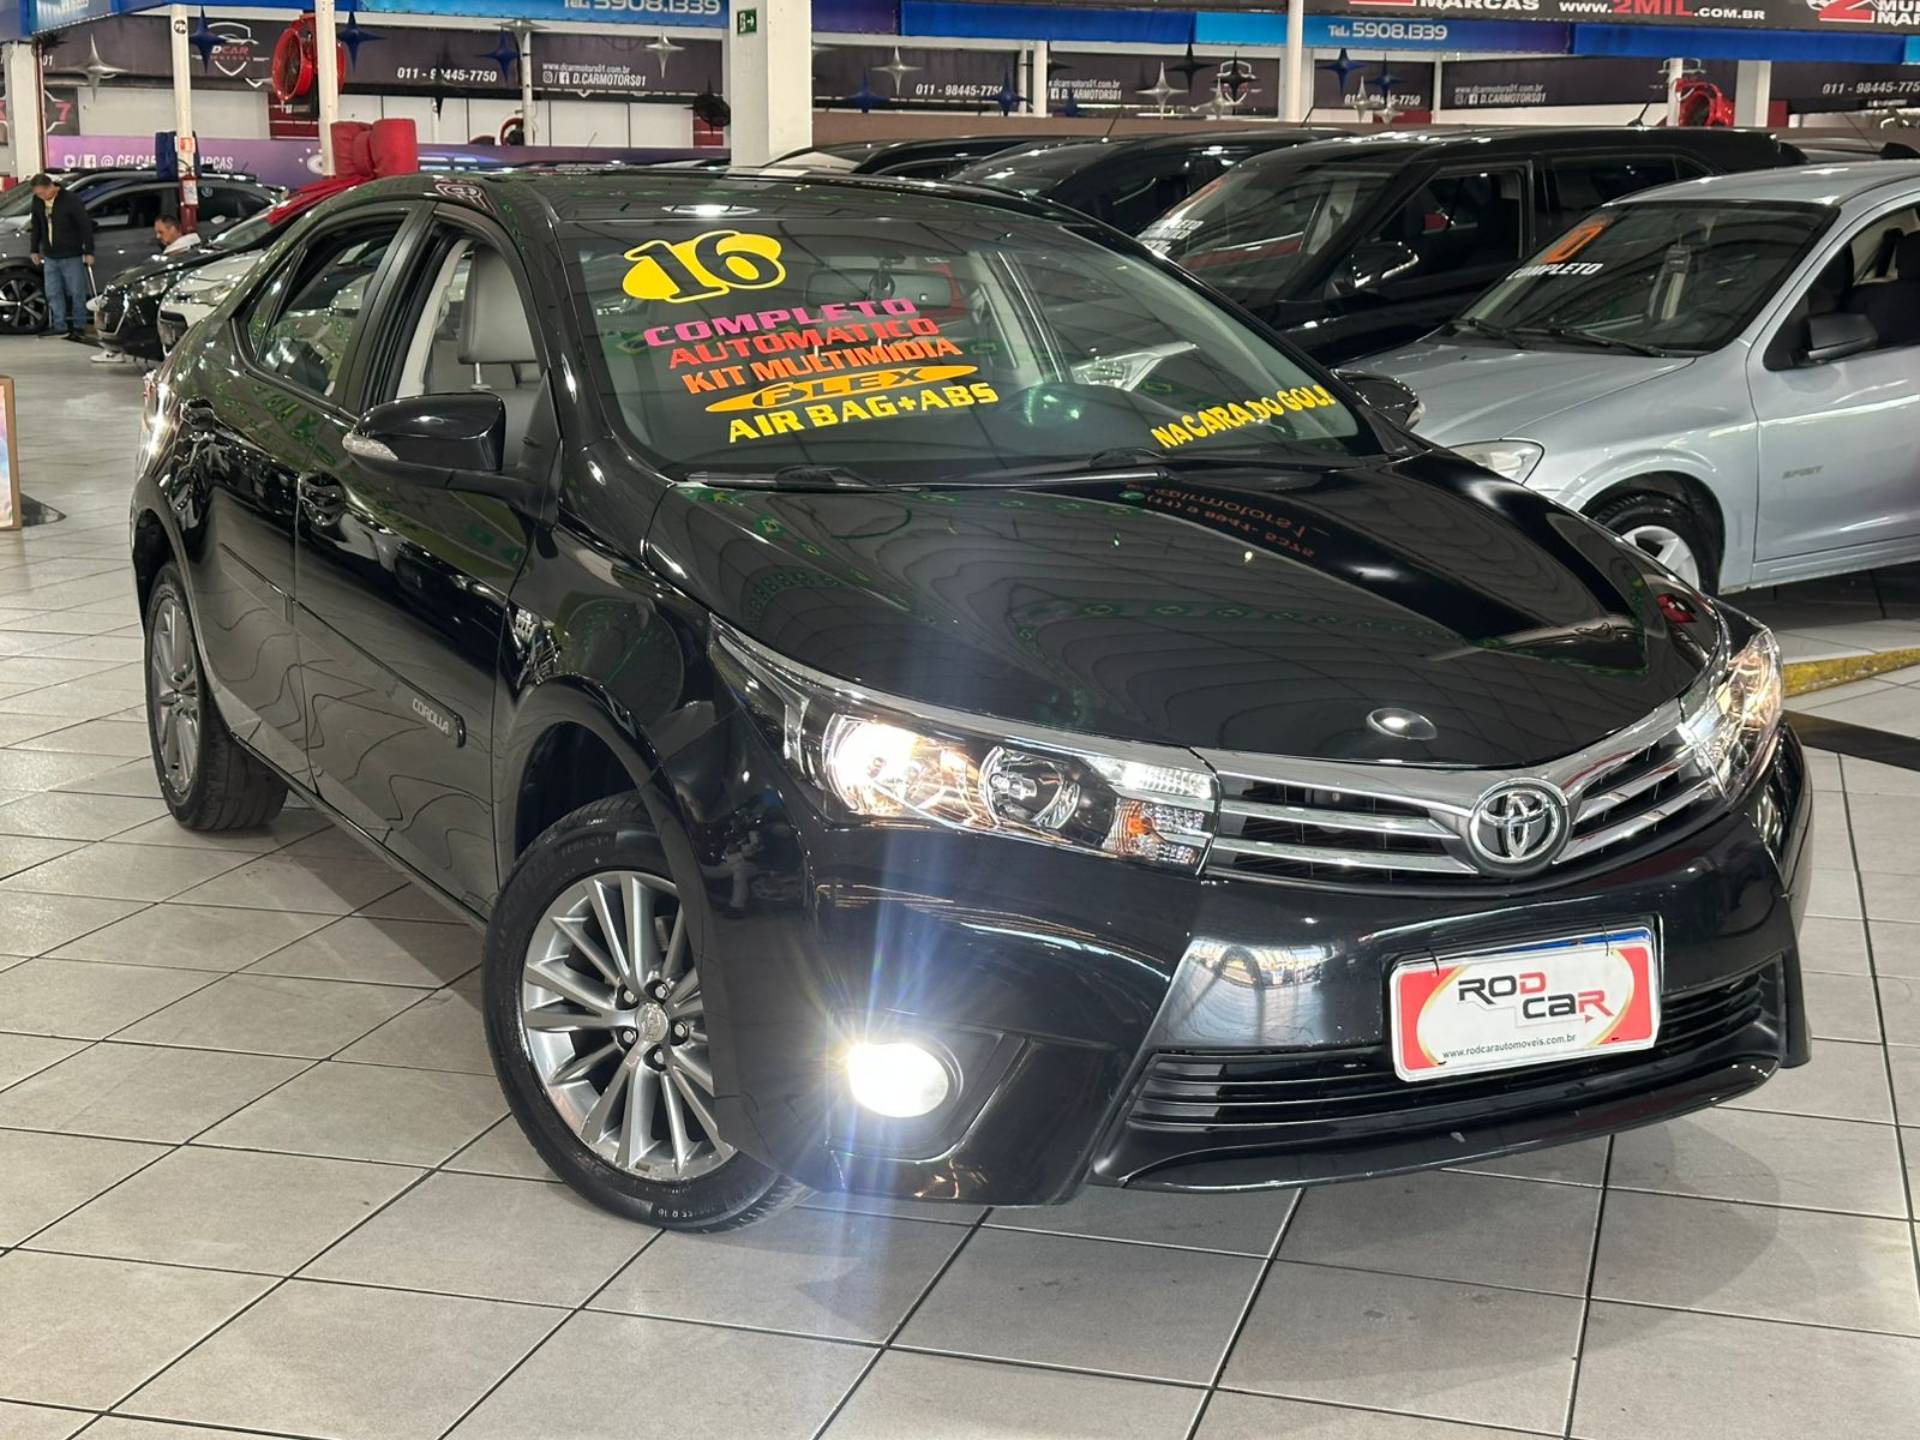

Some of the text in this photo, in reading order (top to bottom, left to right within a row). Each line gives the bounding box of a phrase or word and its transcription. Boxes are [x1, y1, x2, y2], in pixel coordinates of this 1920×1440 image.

[1352, 22, 1448, 40] 5908.1339
[397, 67, 419, 79] 011
[430, 68, 497, 82] 9445-7750
[916, 84, 935, 95] 011
[1822, 83, 1844, 95] 011
[622, 229, 787, 304] 16
[1505, 262, 1604, 282] COMPLETO
[643, 297, 917, 348] COMPLETO
[668, 317, 941, 370] AUTOMATICO
[681, 337, 964, 396] KIT MULTIMIDIA
[750, 367, 928, 410] FLEX
[728, 382, 1000, 444] AIR BAG+ABS
[1150, 422, 1194, 449] NA
[1181, 402, 1256, 438] CARA
[1244, 396, 1285, 421] DO
[412, 698, 449, 735] COROLLA
[1457, 971, 1547, 1006] ROD
[1442, 1033, 1577, 1060] www.rodcarautomoveis.com.br
